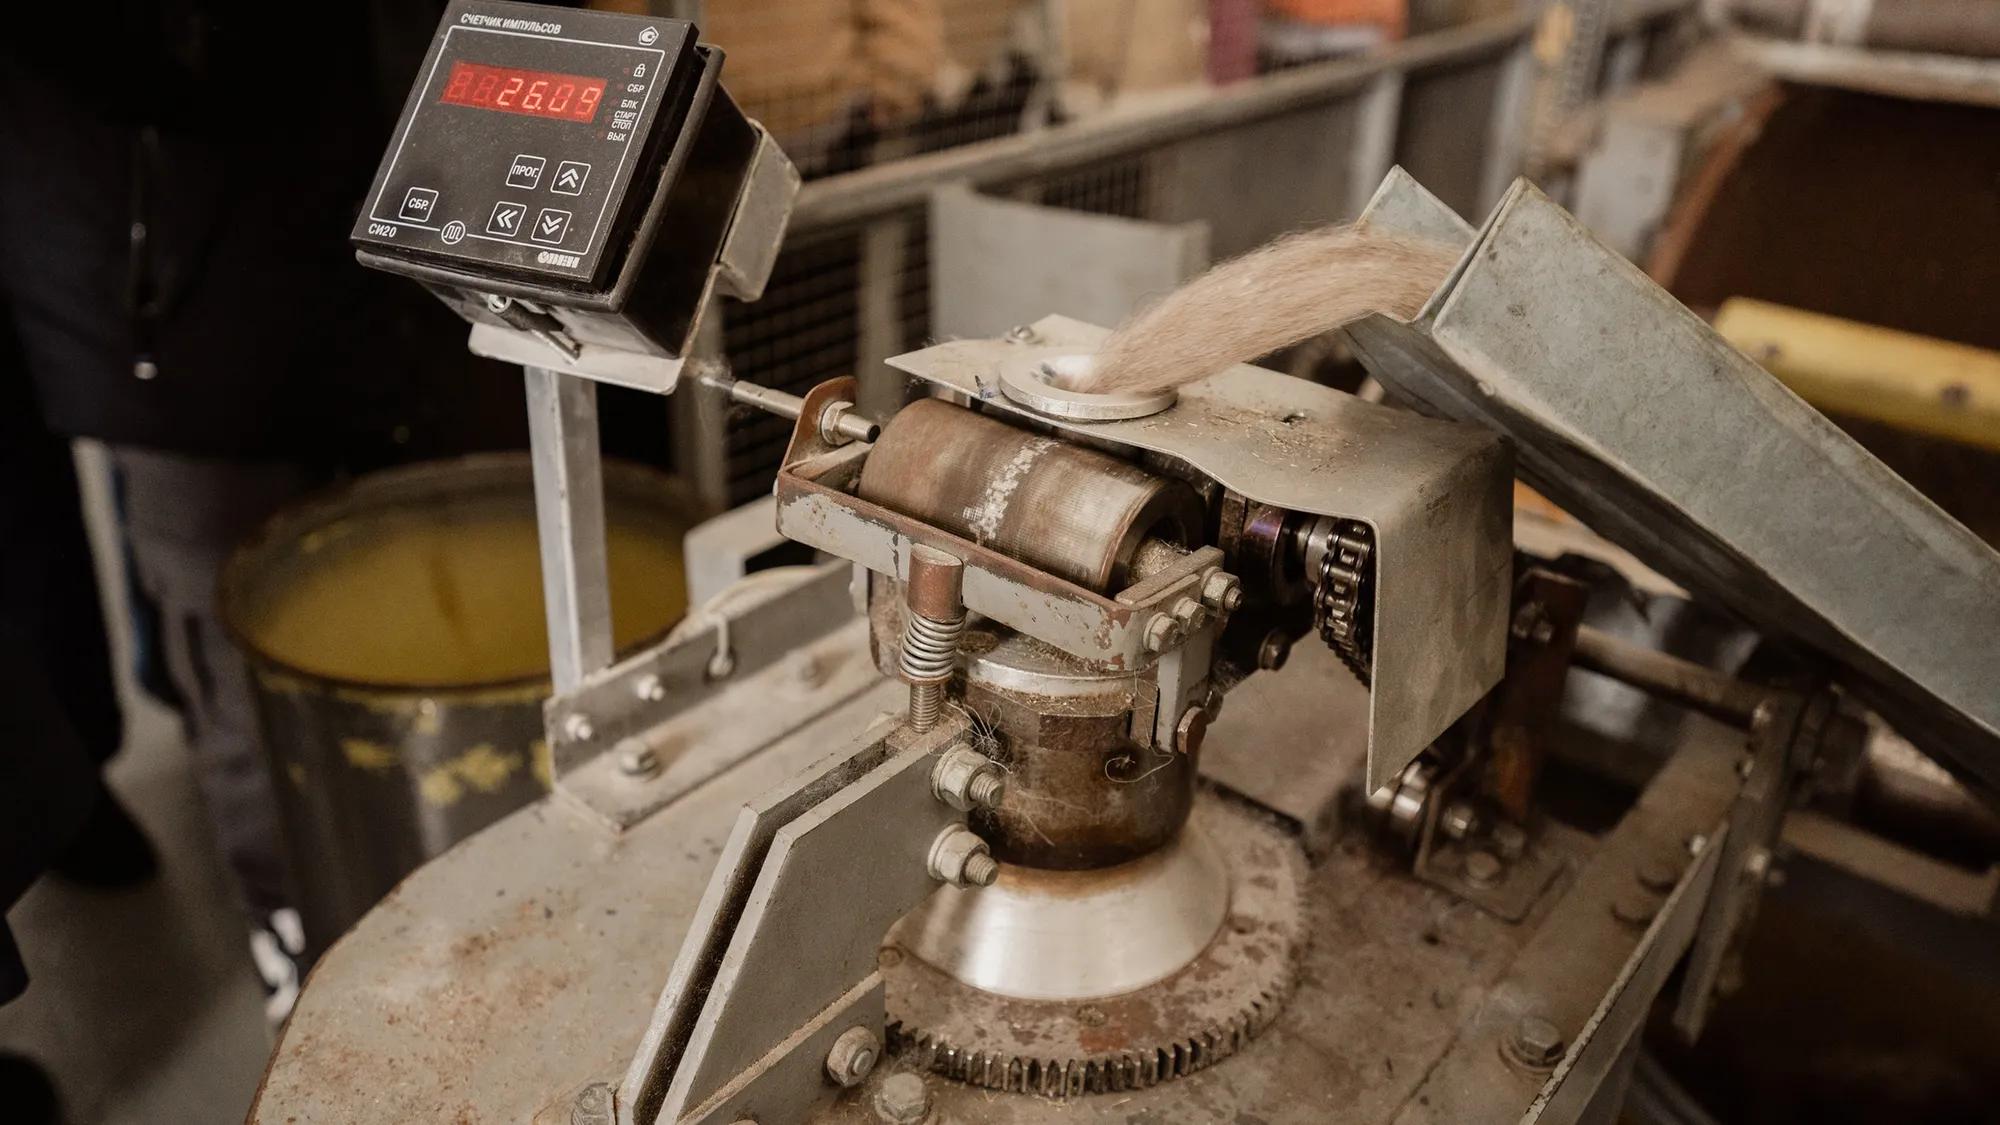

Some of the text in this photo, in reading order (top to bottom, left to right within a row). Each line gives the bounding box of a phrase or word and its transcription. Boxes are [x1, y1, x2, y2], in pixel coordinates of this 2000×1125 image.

[461, 13, 562, 34] СЧЕТЧИК ИМПУЛЬСОВ
[627, 83, 645, 93] СБР
[621, 99, 639, 109] БЛК
[614, 111, 637, 120] СТАРТ
[611, 121, 632, 130] СТОП
[607, 132, 626, 142] ВЫХ
[512, 164, 538, 178] ПРОГ.
[408, 197, 429, 210] СБР.
[368, 223, 397, 238] СИ20
